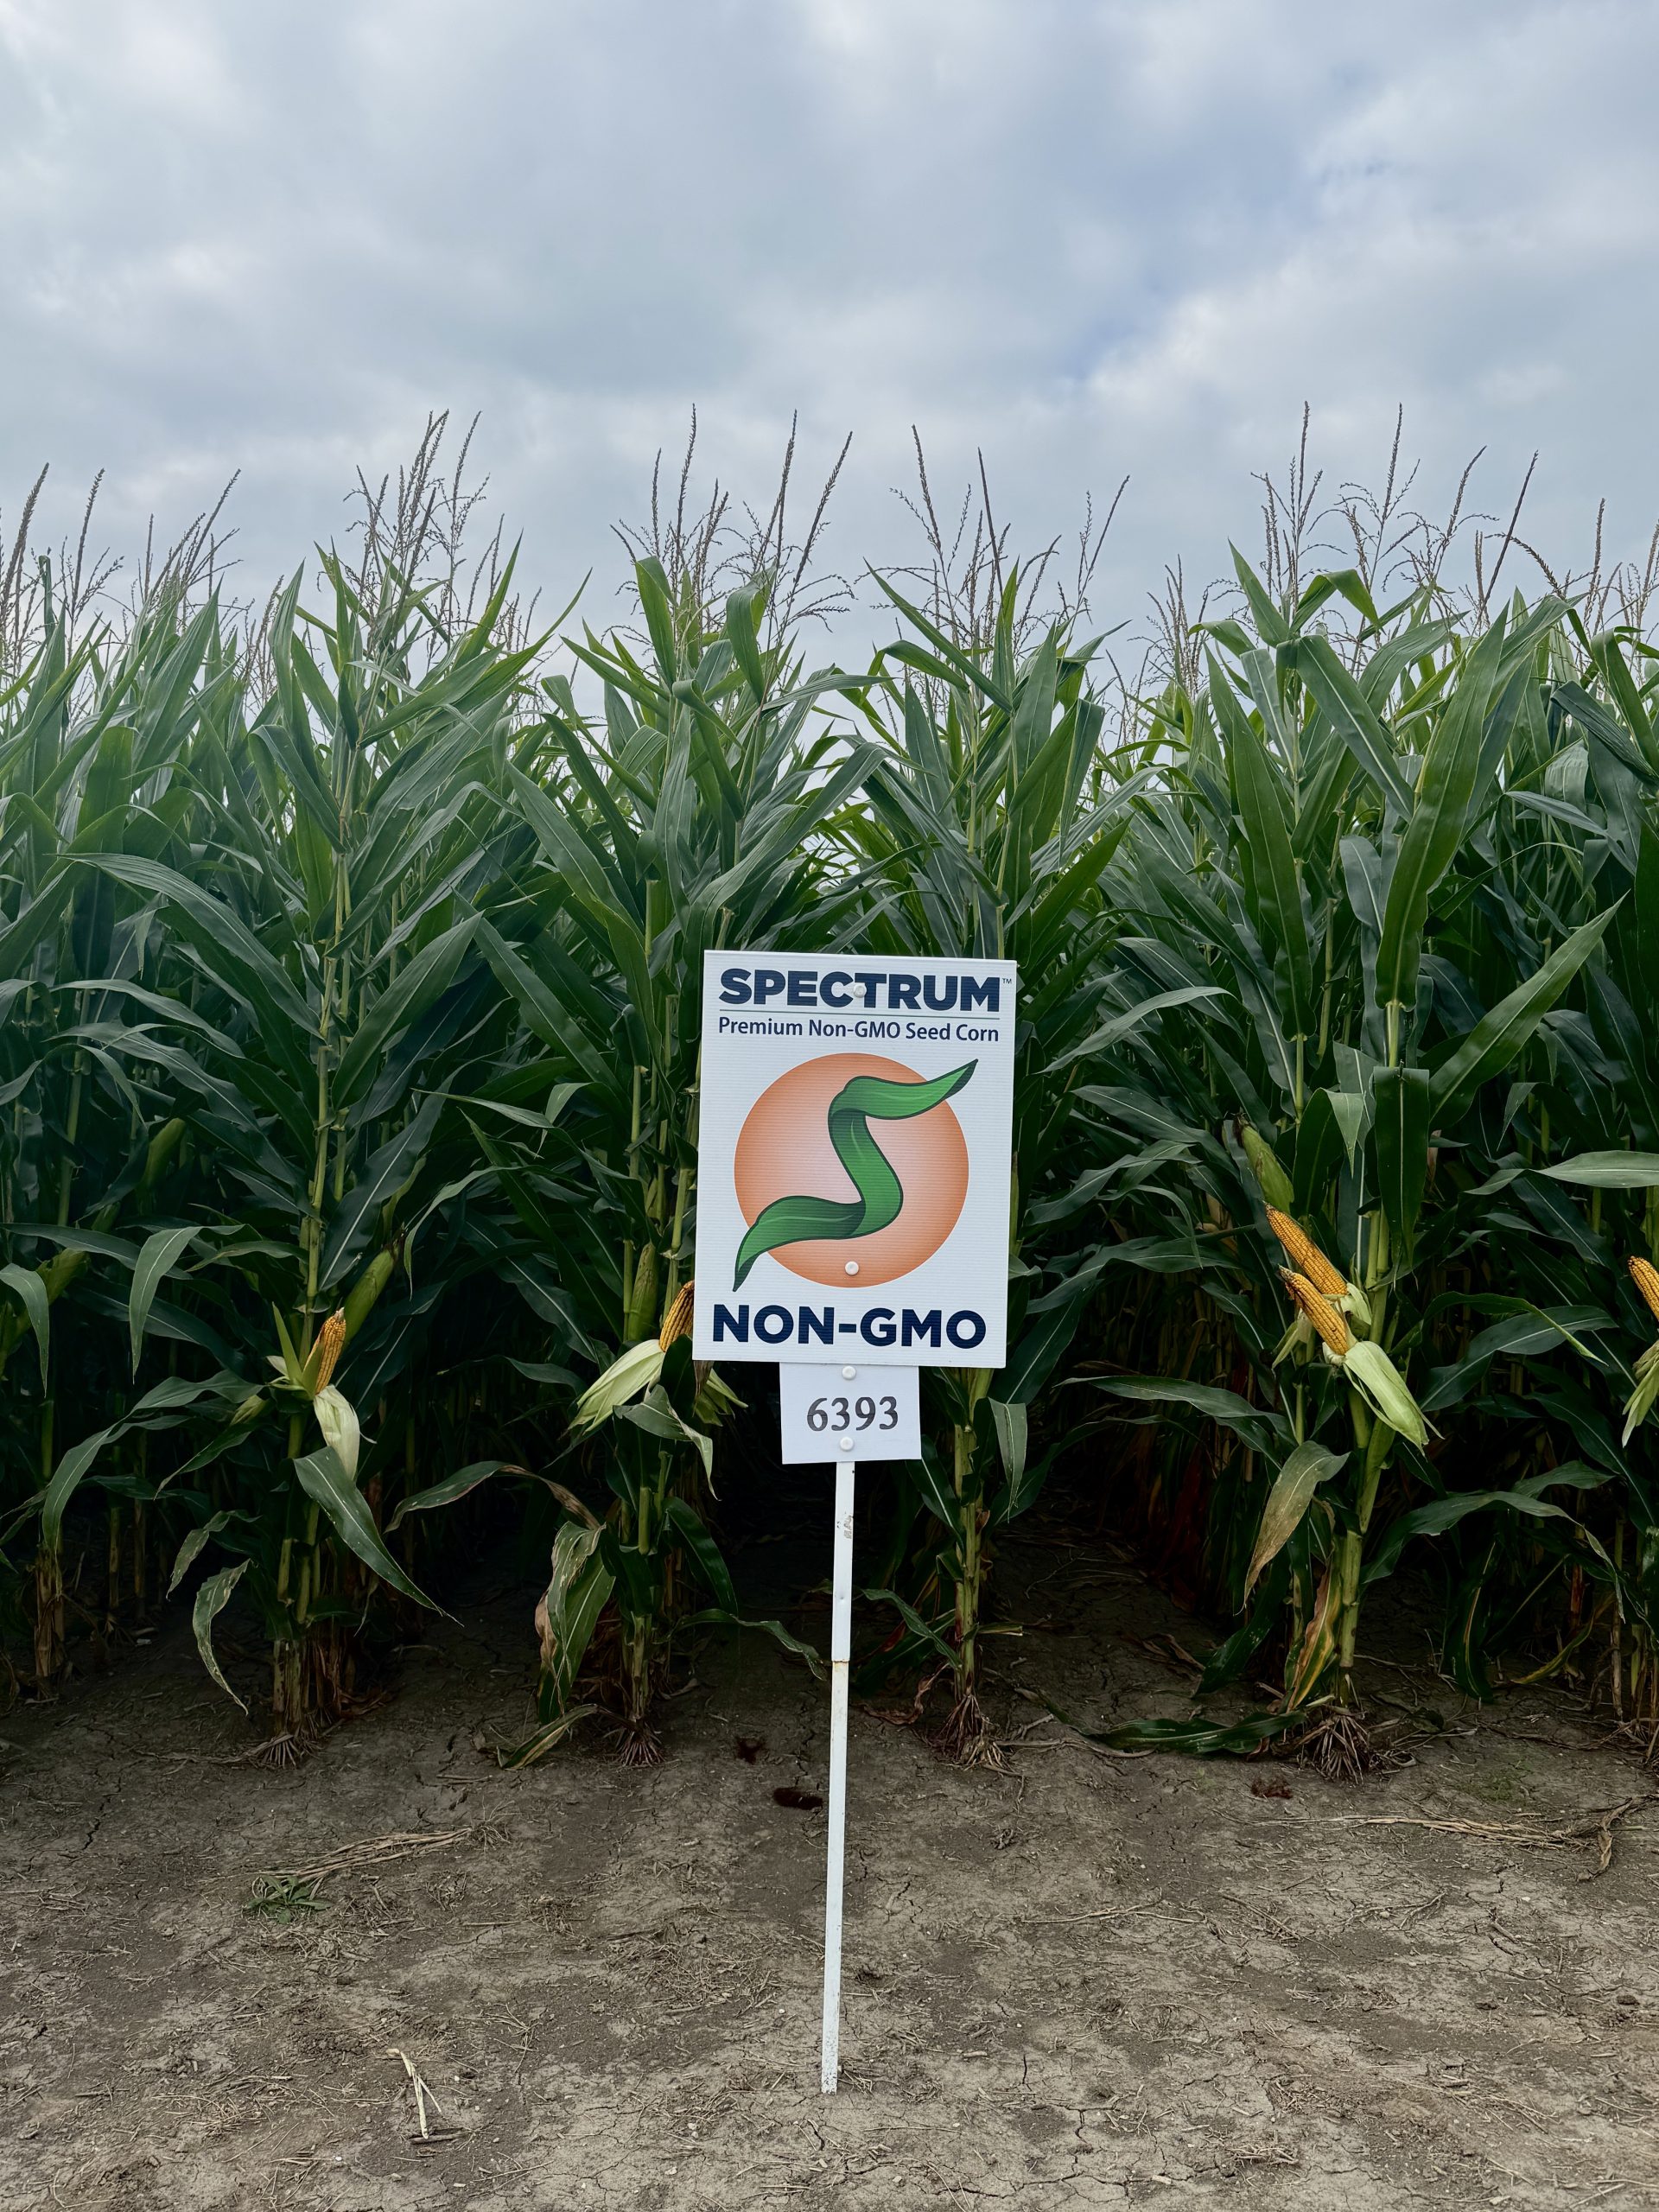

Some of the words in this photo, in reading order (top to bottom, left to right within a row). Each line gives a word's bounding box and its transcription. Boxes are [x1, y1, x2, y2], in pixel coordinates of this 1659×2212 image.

[718, 968, 1000, 1012] SPECTRUM
[718, 1016, 803, 1037] Premium
[809, 1019, 900, 1039] Non-GMO
[906, 1022, 950, 1040] Seed
[956, 1024, 999, 1042] Corn
[712, 1303, 986, 1349] NON-GMO
[806, 1395, 899, 1432] 6393
